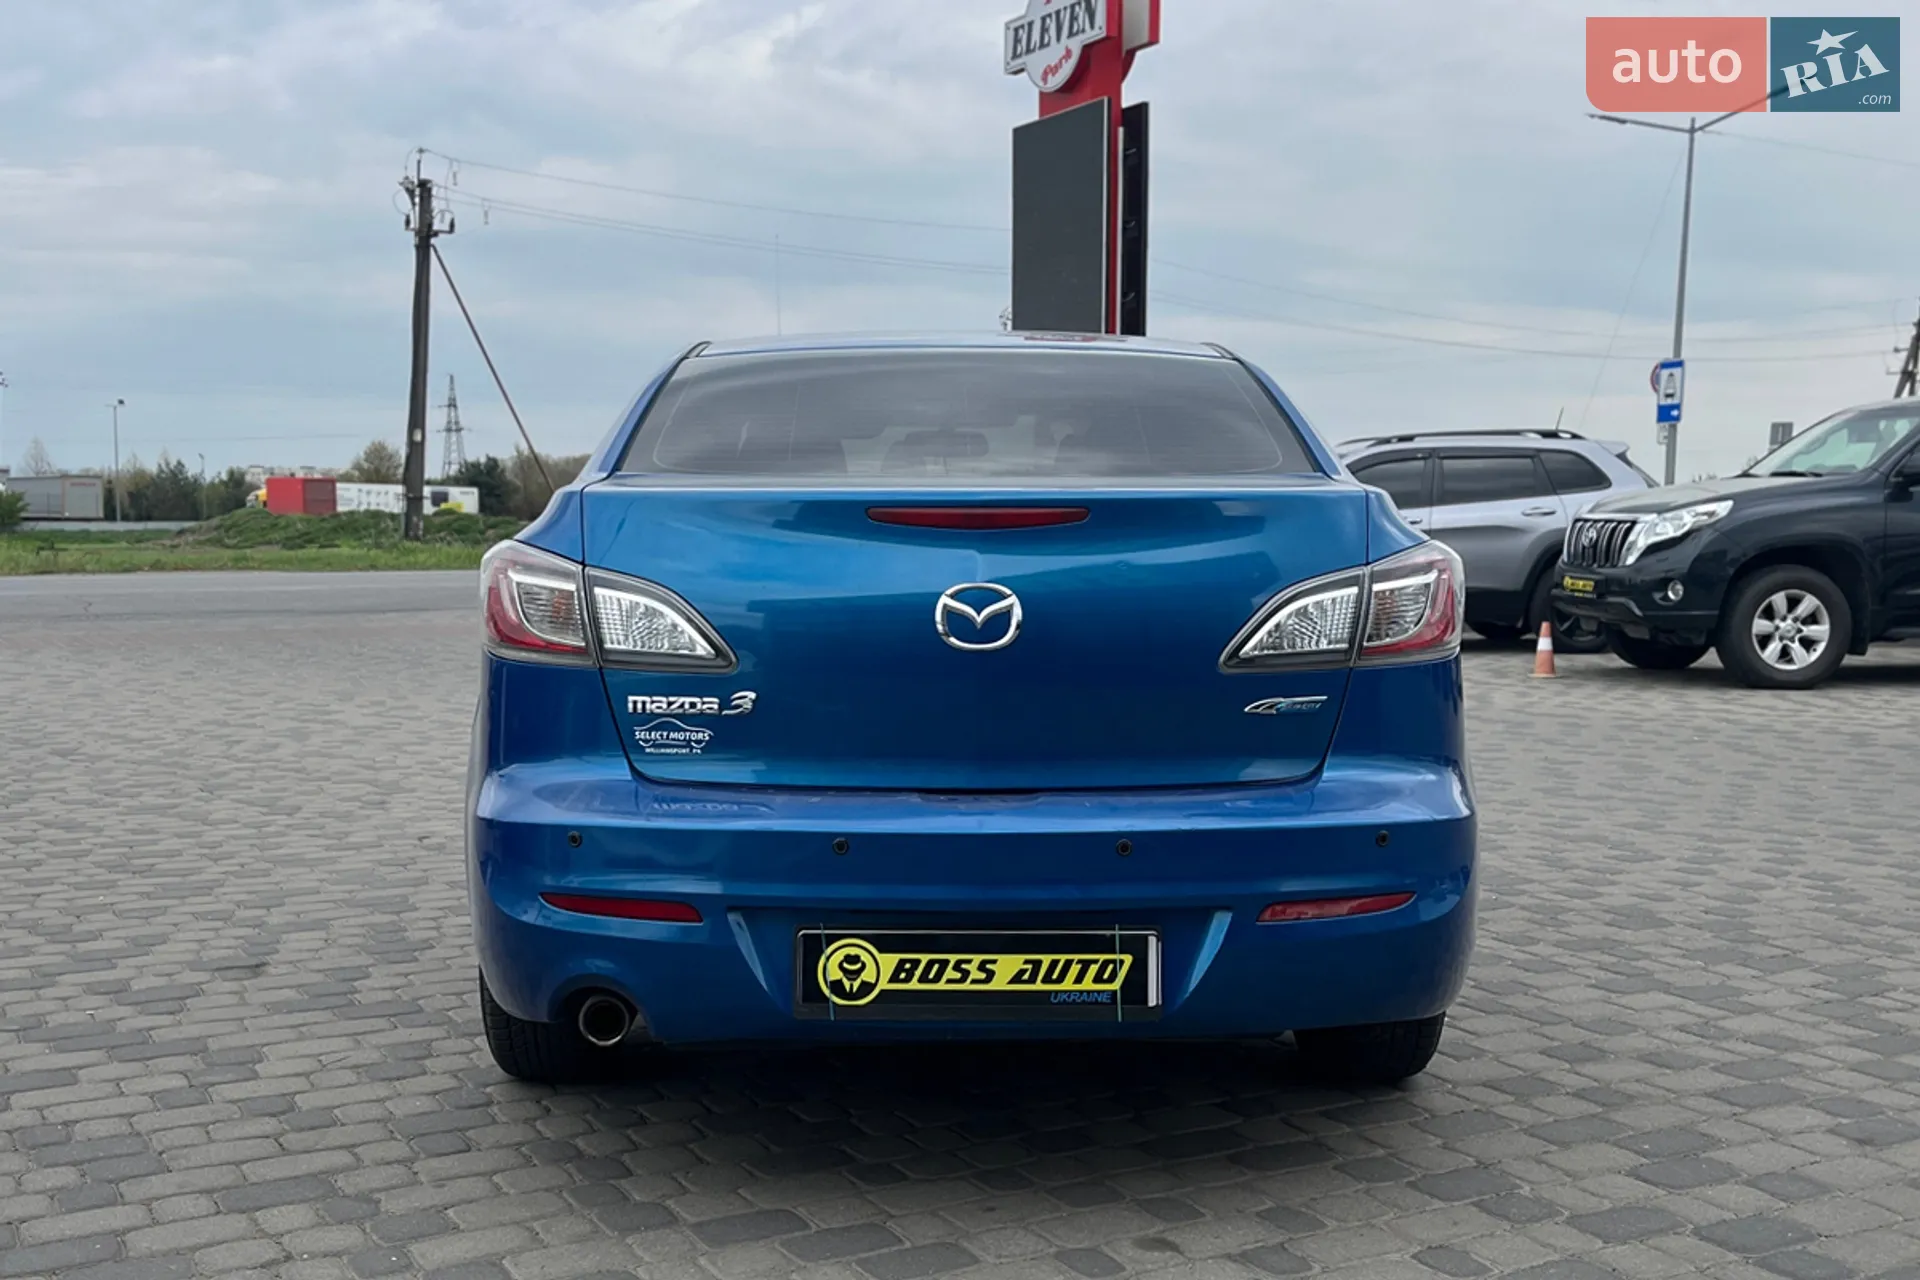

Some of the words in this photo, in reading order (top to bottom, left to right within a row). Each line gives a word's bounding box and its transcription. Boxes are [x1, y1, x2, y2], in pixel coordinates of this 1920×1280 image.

[1010, 0, 1098, 61] ELEVEN
[721, 690, 757, 715] 3
[634, 731, 667, 740] SELECT
[669, 731, 709, 741] MOTORS
[887, 958, 999, 984] BOSS
[1006, 958, 1124, 985] AUTO
[1049, 991, 1112, 1003] UKRAINE
